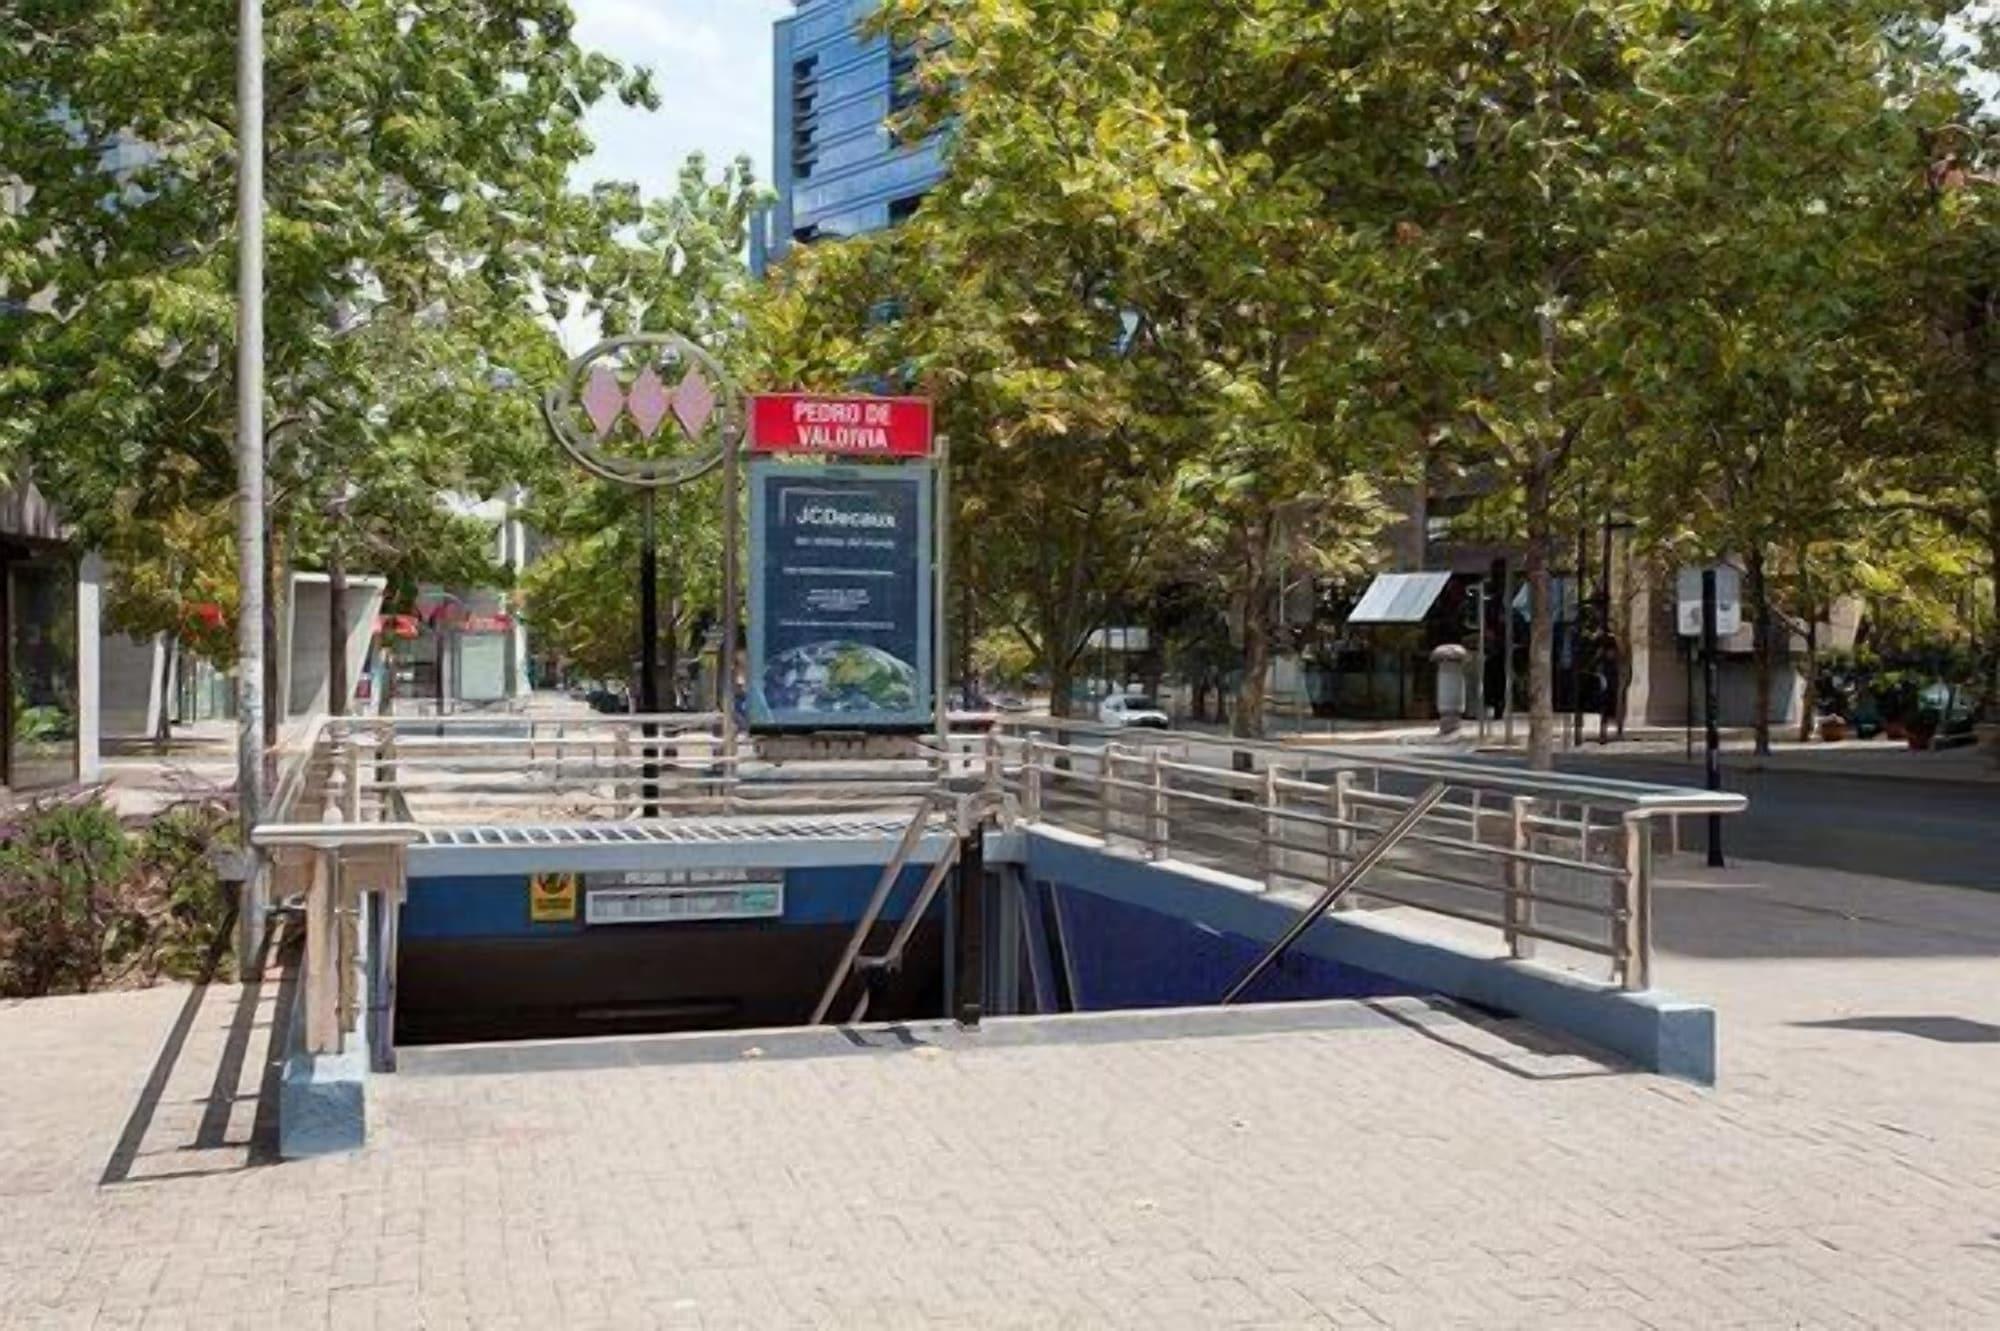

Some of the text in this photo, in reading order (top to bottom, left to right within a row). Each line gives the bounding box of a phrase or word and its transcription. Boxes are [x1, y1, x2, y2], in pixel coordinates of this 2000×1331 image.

[793, 401, 892, 426] PEDRO DE
[797, 425, 888, 448] VALDIVIA
